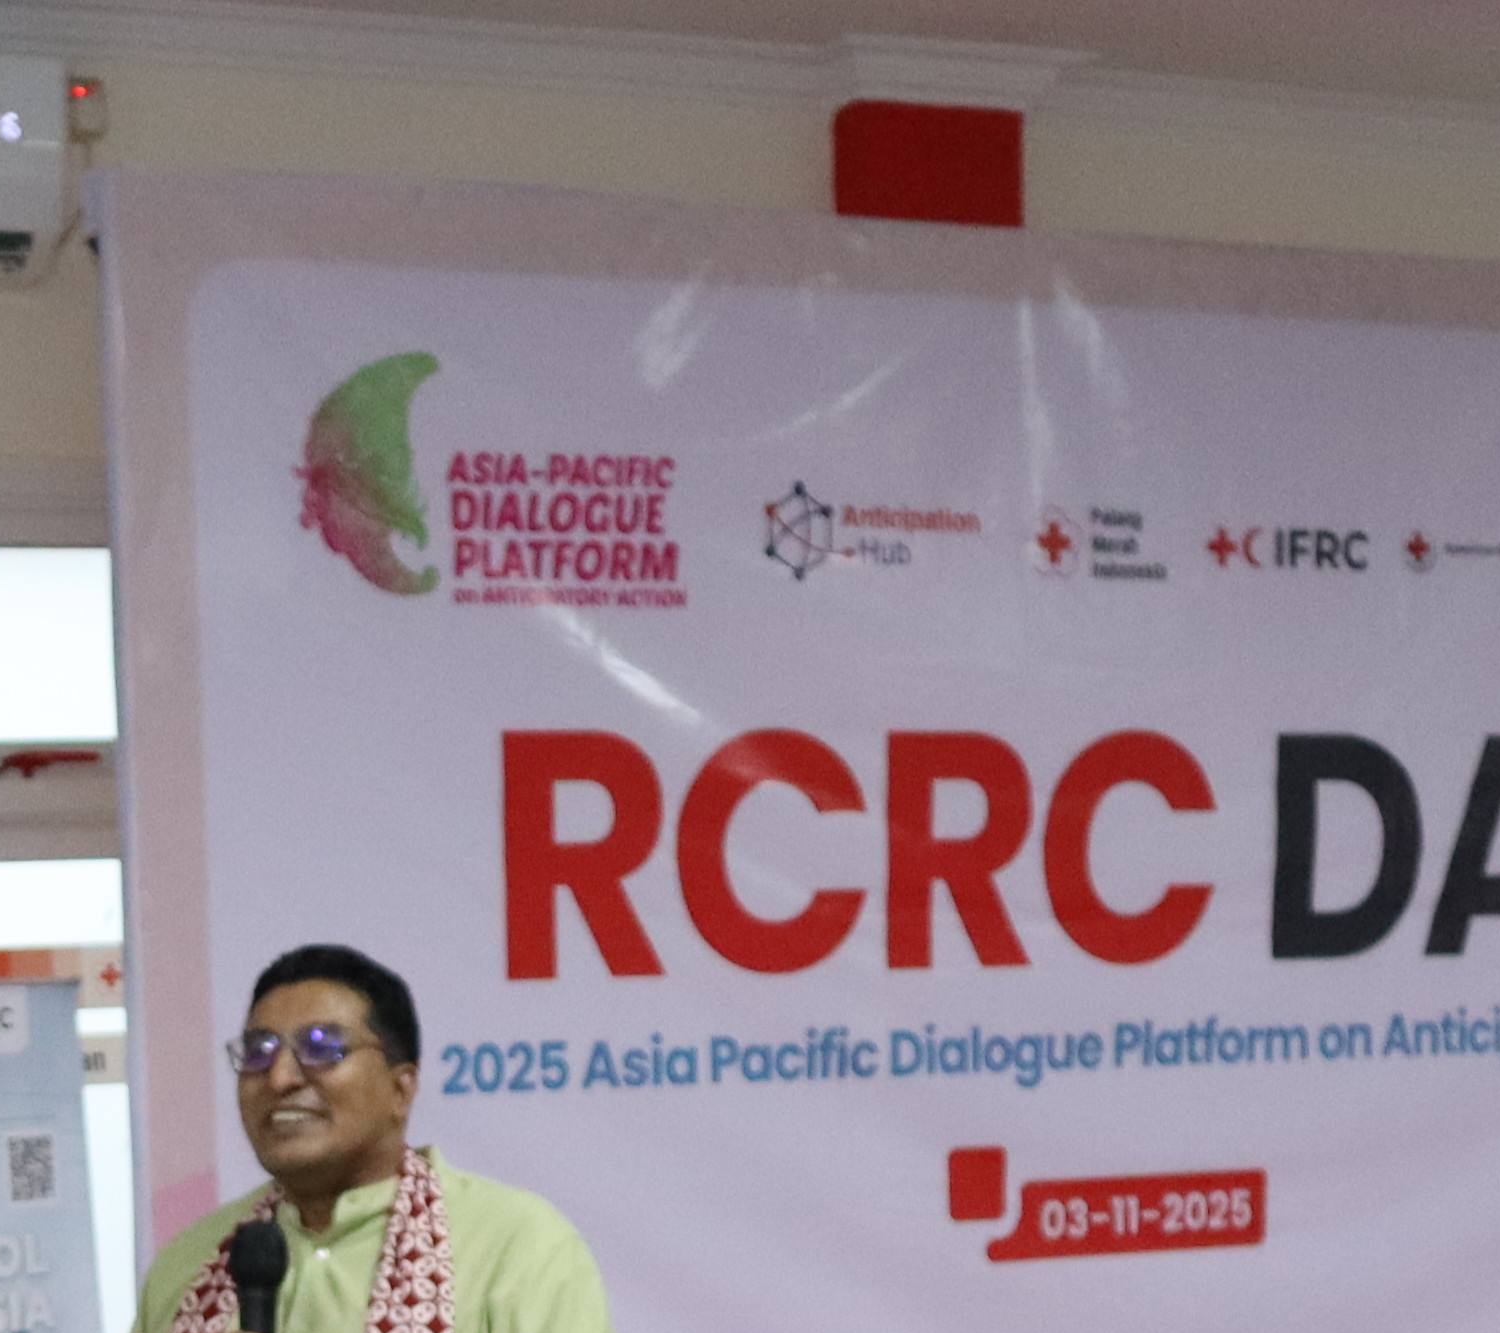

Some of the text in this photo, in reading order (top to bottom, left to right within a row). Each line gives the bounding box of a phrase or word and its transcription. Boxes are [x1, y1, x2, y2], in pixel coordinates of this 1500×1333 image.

[447, 452, 677, 488] ASIA-PACIFIC
[451, 492, 666, 536] DIALOGUE
[841, 507, 982, 534] Anticipation
[453, 540, 680, 582] PLATFORM
[860, 539, 912, 565] Hub
[1274, 528, 1370, 571] IFRC
[498, 727, 1219, 982] RCRC
[440, 1040, 570, 1096] 2025
[581, 1032, 700, 1090] Asia
[710, 1025, 881, 1084] Pacific
[887, 1021, 1104, 1090] Dialogue
[1113, 1014, 1311, 1068] Platform
[1318, 1021, 1374, 1059] on
[1037, 1184, 1254, 1244] 03-11-2025
